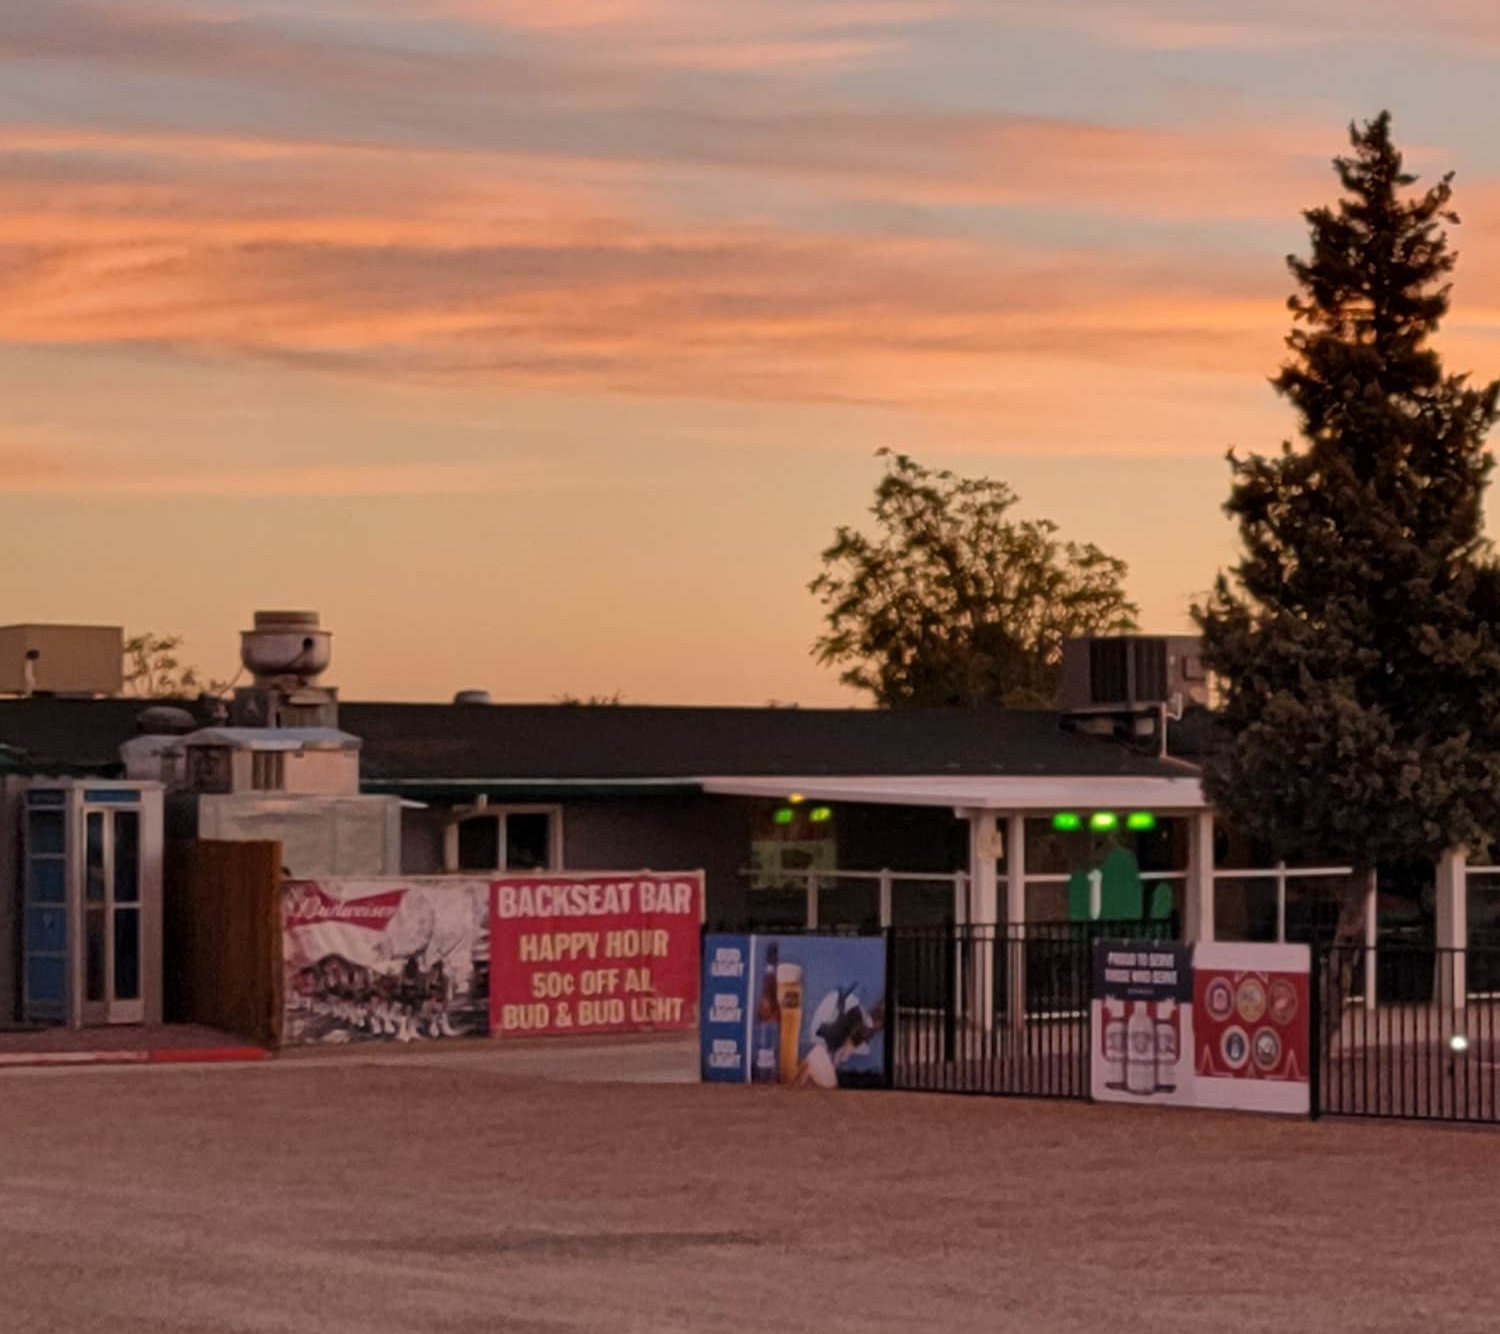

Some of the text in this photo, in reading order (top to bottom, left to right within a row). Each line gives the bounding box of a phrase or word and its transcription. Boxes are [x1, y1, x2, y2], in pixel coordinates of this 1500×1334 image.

[498, 881, 692, 919] BACKSEAT BAR
[520, 929, 669, 962] HAPPY HOUR
[532, 971, 575, 998] 50¢
[580, 969, 619, 995] OFF
[503, 1003, 549, 1030] BUD
[555, 1002, 573, 1027] &
[578, 999, 625, 1026] BUD
